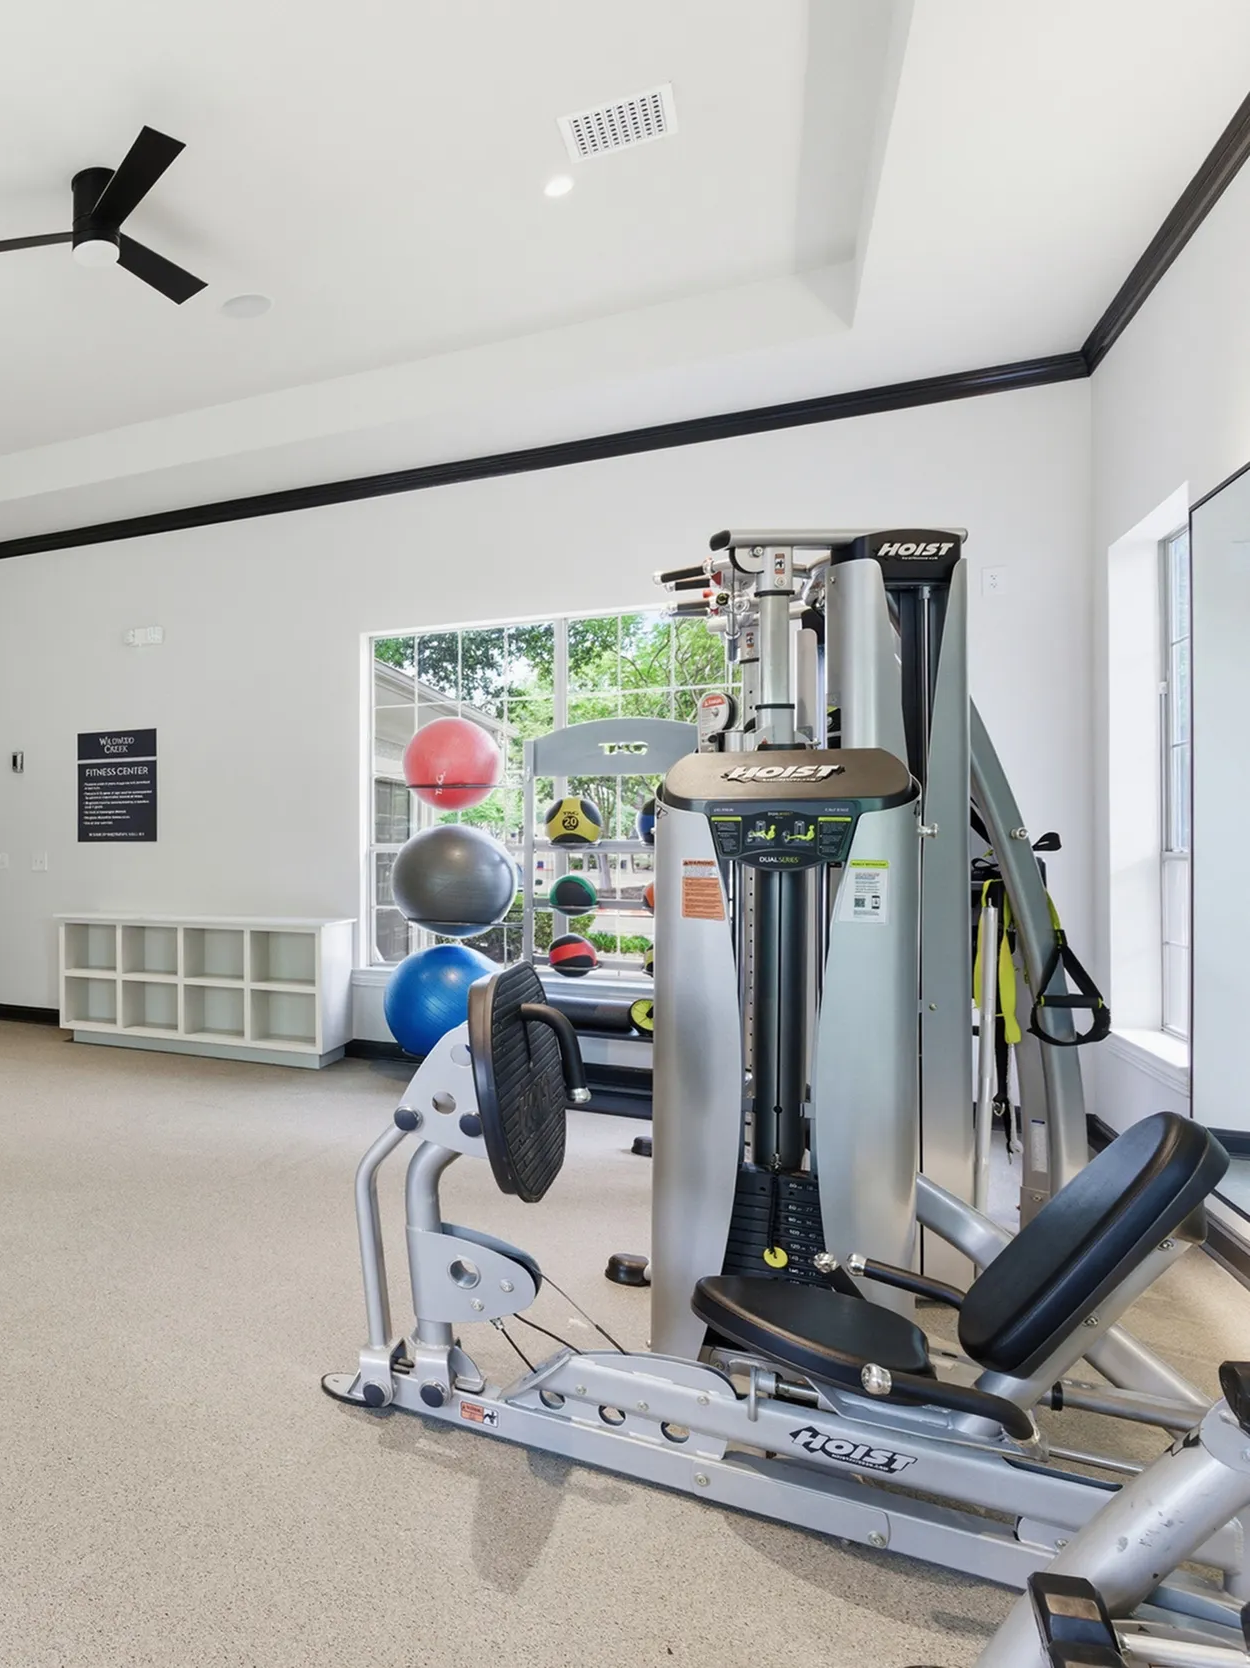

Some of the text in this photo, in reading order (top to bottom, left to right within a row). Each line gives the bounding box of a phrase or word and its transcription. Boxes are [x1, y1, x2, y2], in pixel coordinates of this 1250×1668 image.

[877, 542, 954, 557] HOIST
[85, 766, 149, 777] FITNESS CENTER
[726, 764, 842, 780] HOIST
[564, 817, 577, 827] 20
[792, 1429, 917, 1471] HOIST
